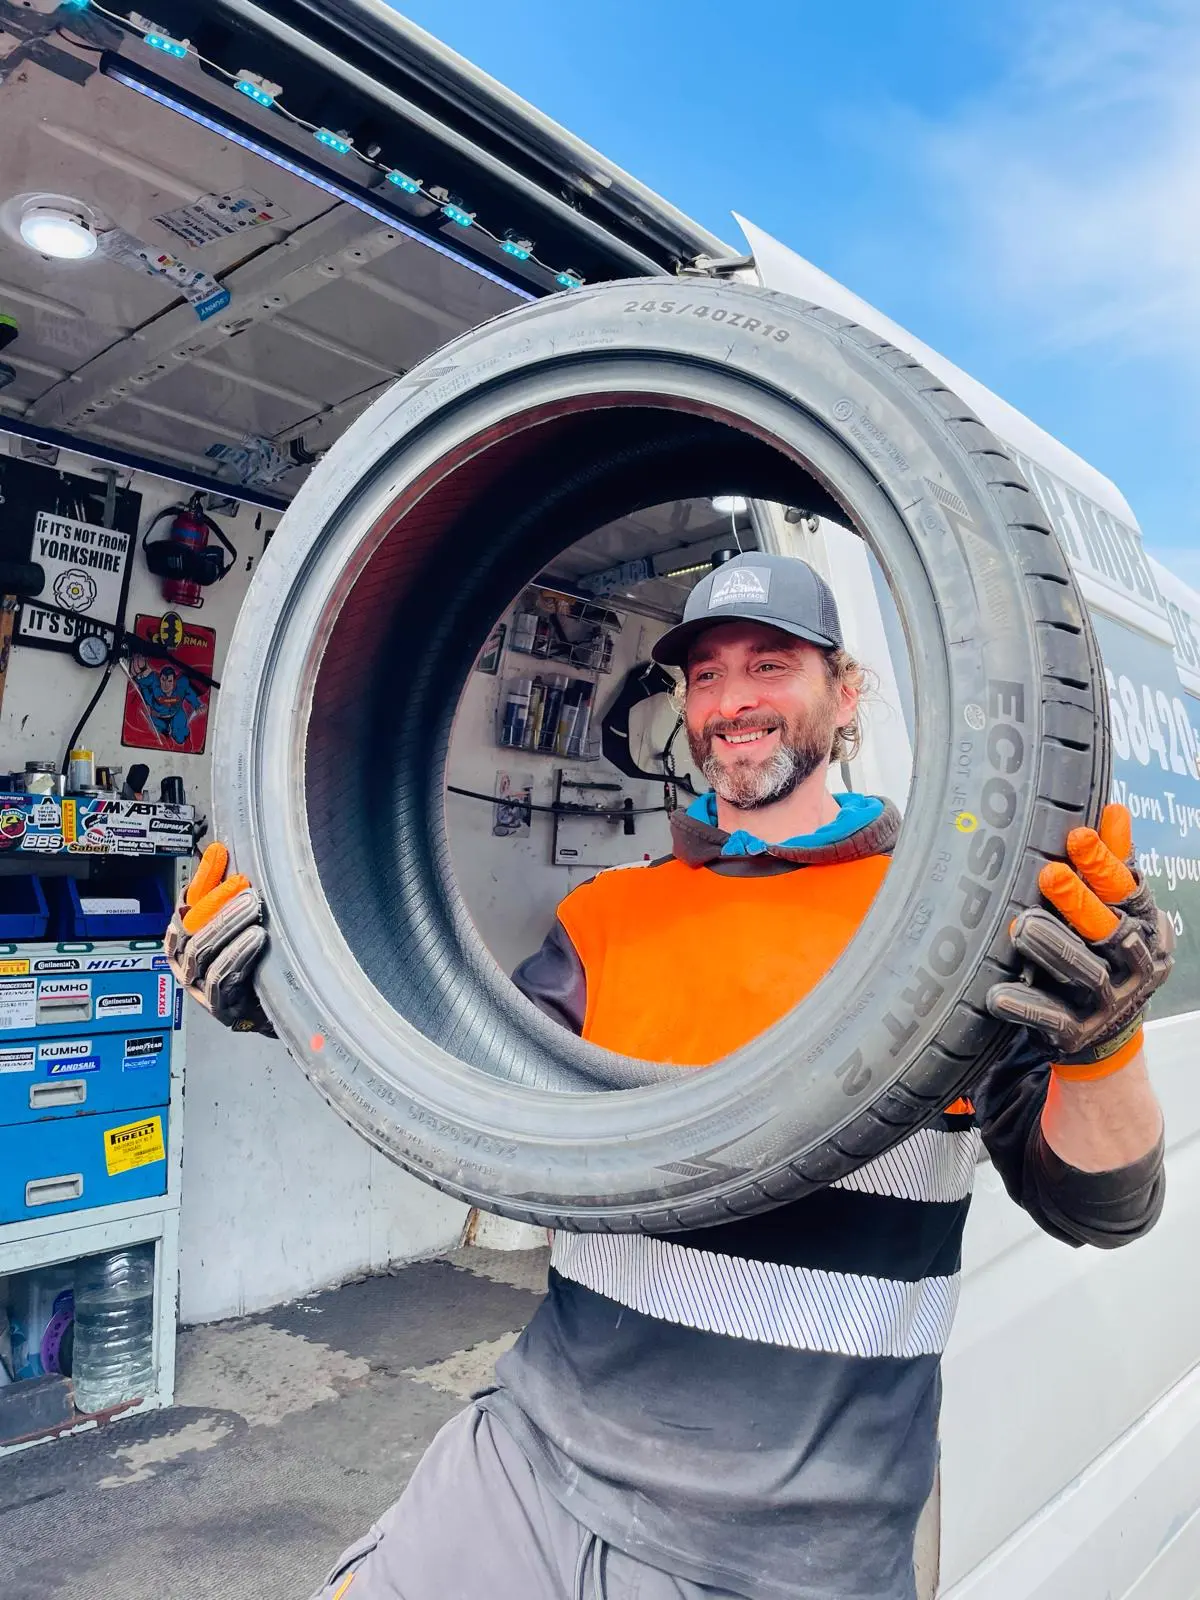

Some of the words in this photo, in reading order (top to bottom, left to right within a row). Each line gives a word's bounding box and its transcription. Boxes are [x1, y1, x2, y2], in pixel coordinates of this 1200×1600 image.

[623, 300, 792, 344] 245/40ZR19
[37, 518, 49, 533] IF
[50, 521, 72, 539] IT'S
[74, 527, 97, 545] NOT
[98, 533, 128, 553] FROM
[40, 538, 121, 573] YORKSHIRE
[29, 609, 61, 634] IT'S
[956, 739, 974, 779] DOT
[125, 802, 162, 818] ABT
[23, 835, 63, 848] BBS
[881, 679, 1025, 1058] ECOSPORT
[38, 960, 72, 970] Continental
[87, 958, 143, 970] HIFLY
[41, 983, 88, 993] KUMHO
[102, 997, 133, 1007] Continental
[41, 1045, 89, 1056] KUMHO
[51, 1060, 96, 1073] LANDSAIL
[833, 1047, 873, 1097] 2
[110, 1122, 155, 1146] PIRELLI
